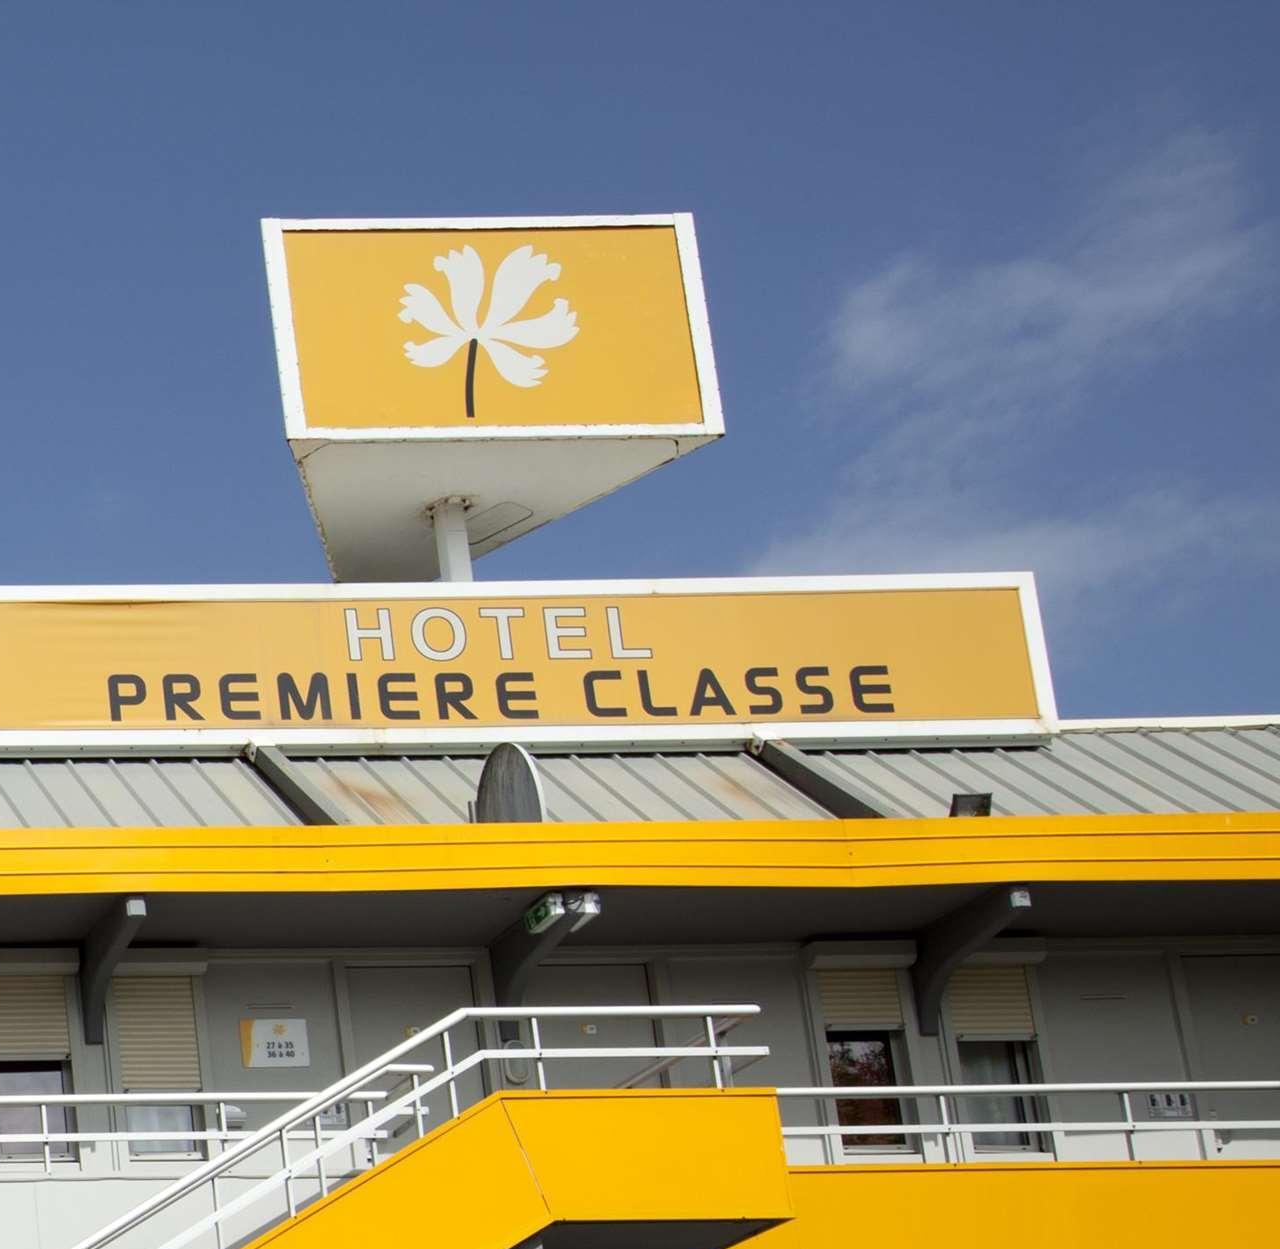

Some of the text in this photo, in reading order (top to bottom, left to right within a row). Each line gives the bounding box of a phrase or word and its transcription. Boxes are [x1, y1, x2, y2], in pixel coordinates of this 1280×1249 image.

[344, 604, 653, 662] HOTEL
[108, 664, 897, 723] PREMIERE CLASSE
